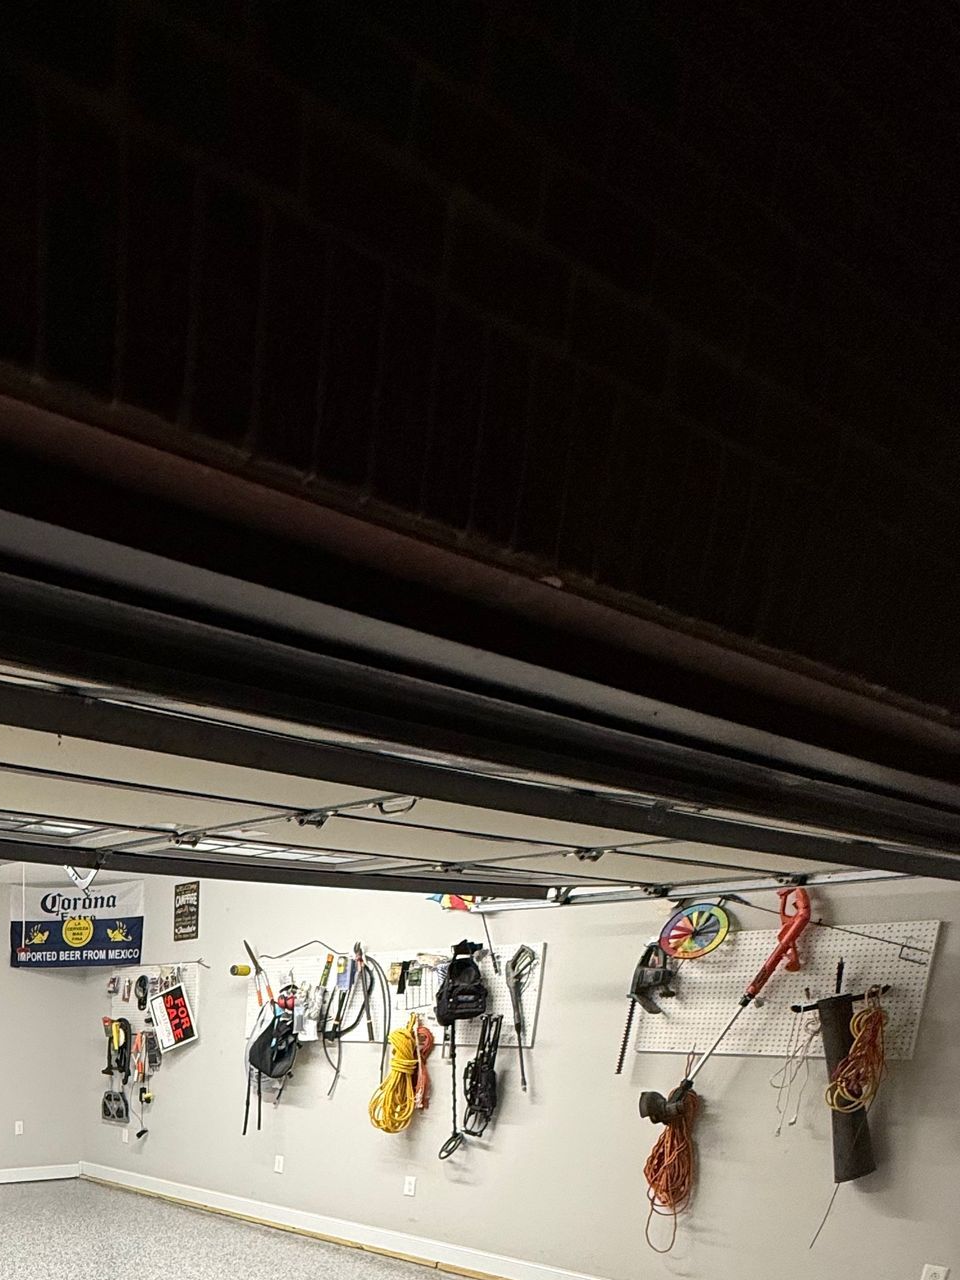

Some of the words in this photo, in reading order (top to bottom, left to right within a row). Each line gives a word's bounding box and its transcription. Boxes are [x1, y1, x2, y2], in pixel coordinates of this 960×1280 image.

[41, 892, 117, 916] Corona
[59, 950, 81, 961] BEER
[82, 949, 106, 960] FROM
[108, 948, 140, 959] MEXICO
[164, 995, 184, 1041] SALE
[175, 997, 191, 1029] FOR
